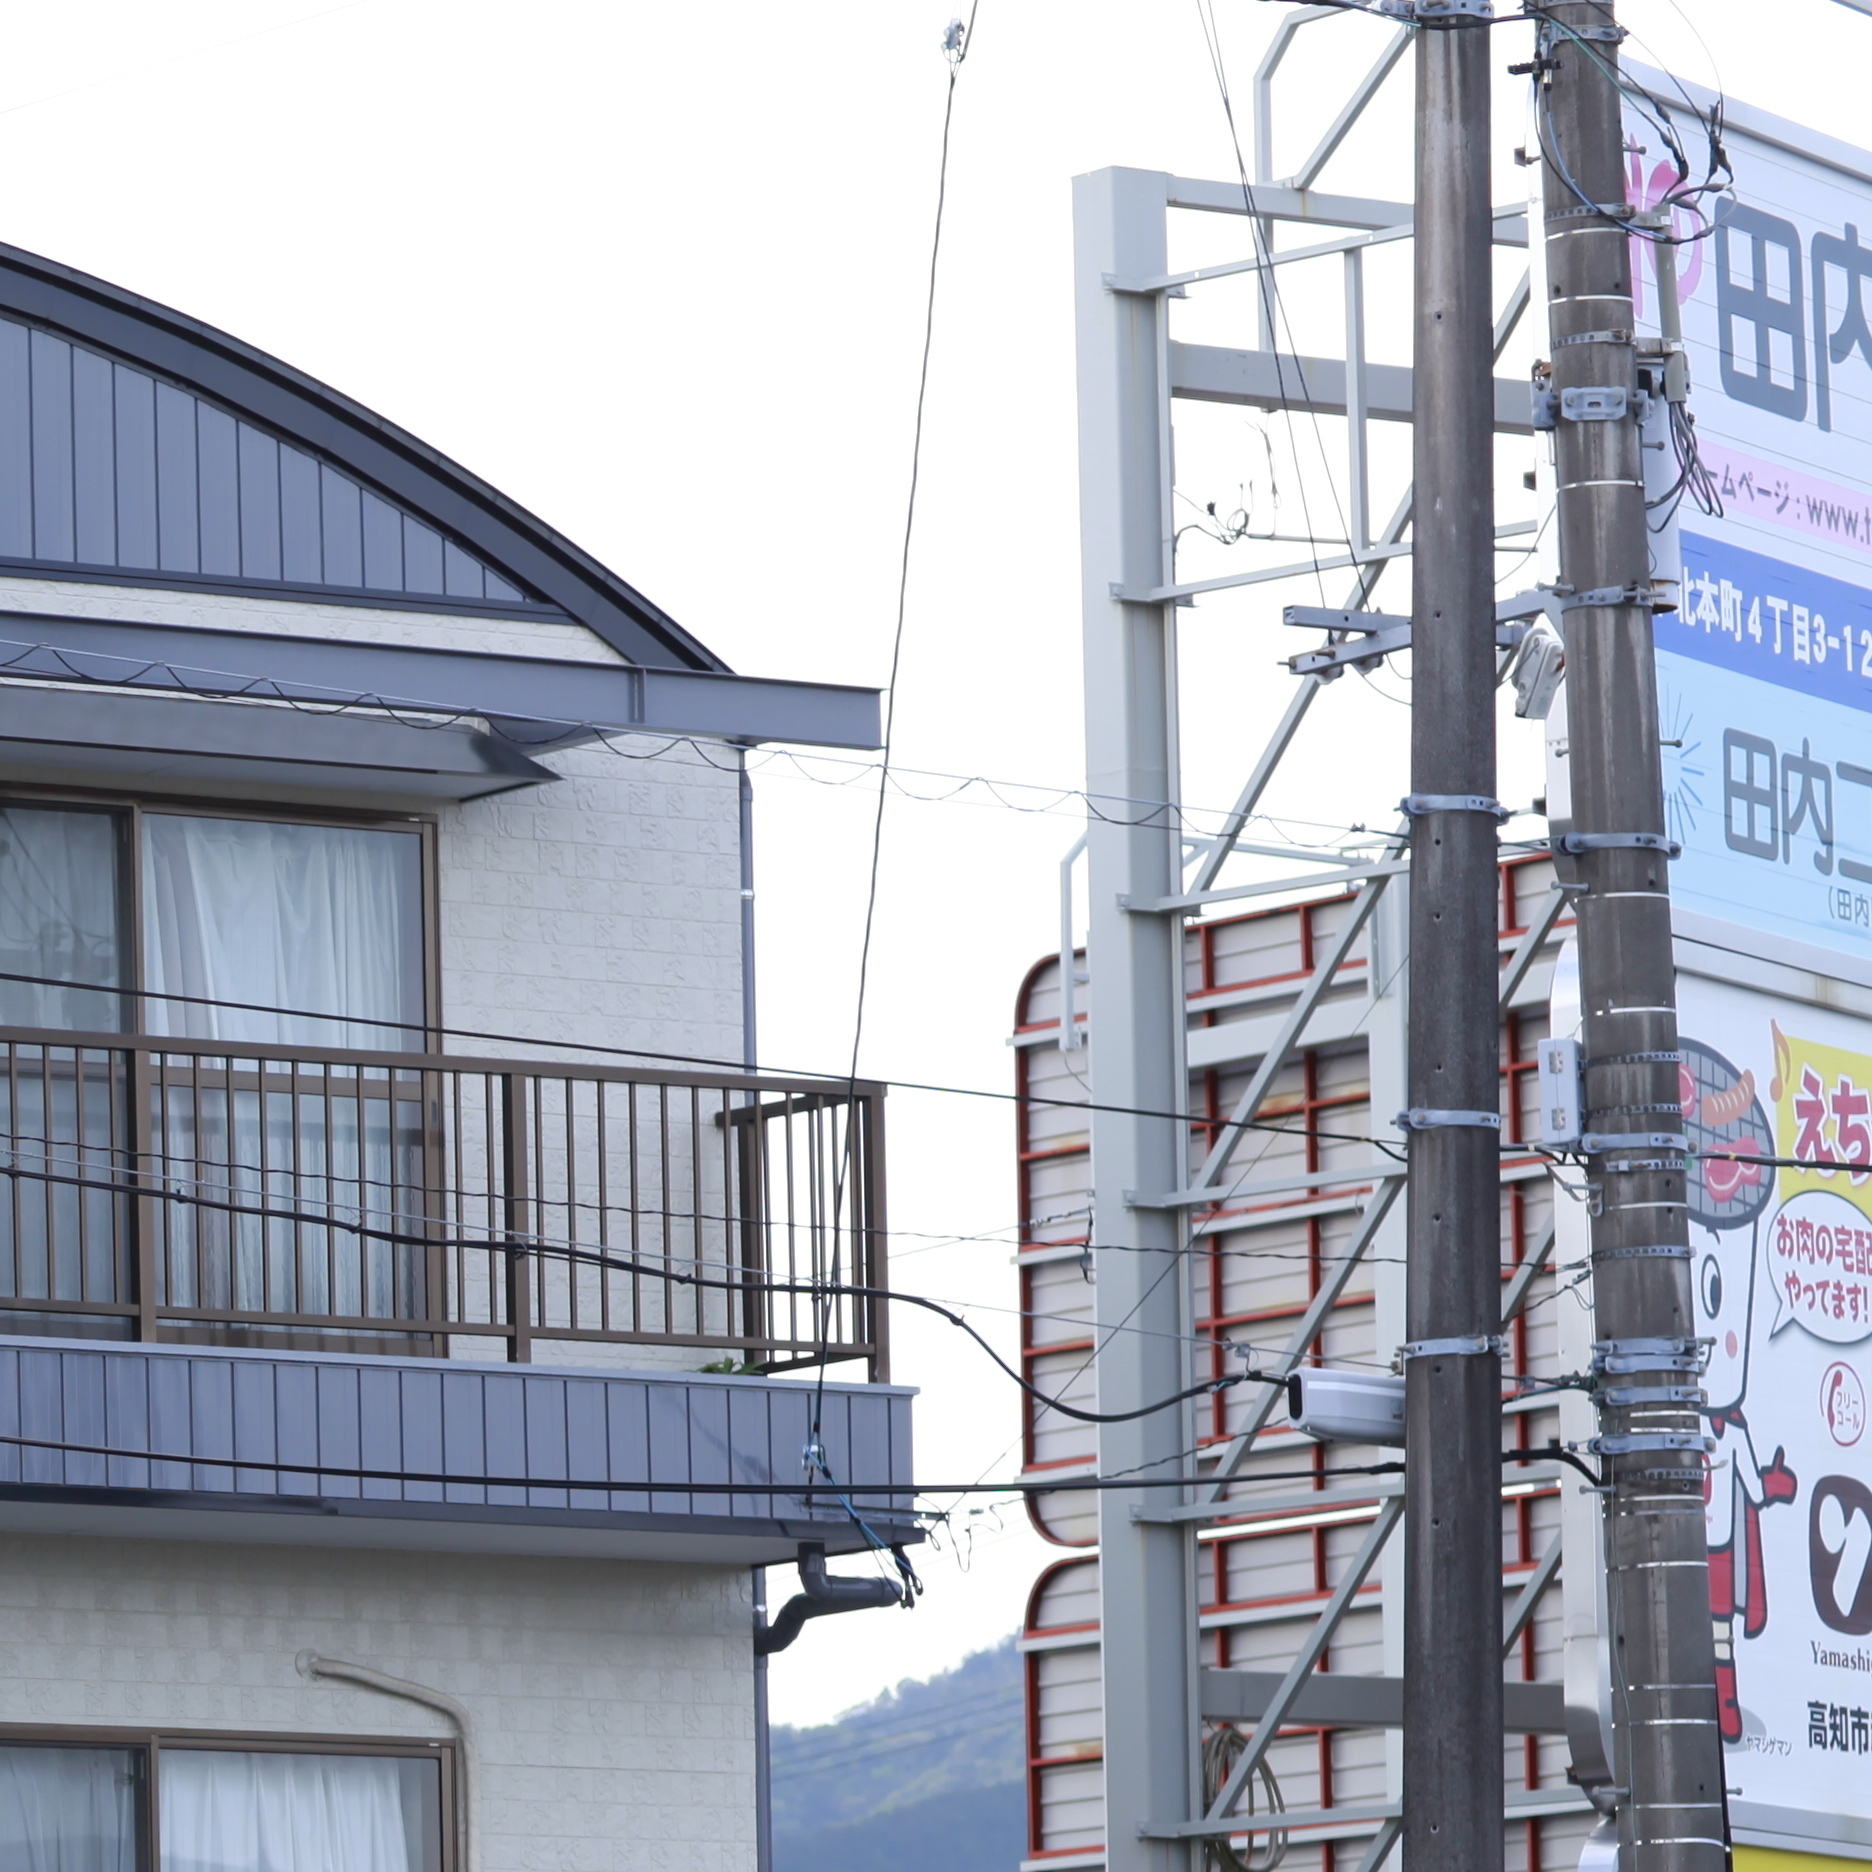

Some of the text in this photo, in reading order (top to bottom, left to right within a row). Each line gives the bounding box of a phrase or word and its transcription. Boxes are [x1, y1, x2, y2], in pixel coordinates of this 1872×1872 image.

[1810, 1640, 1872, 1674] Yamashi
[1807, 1700, 1872, 1756] 高知市
